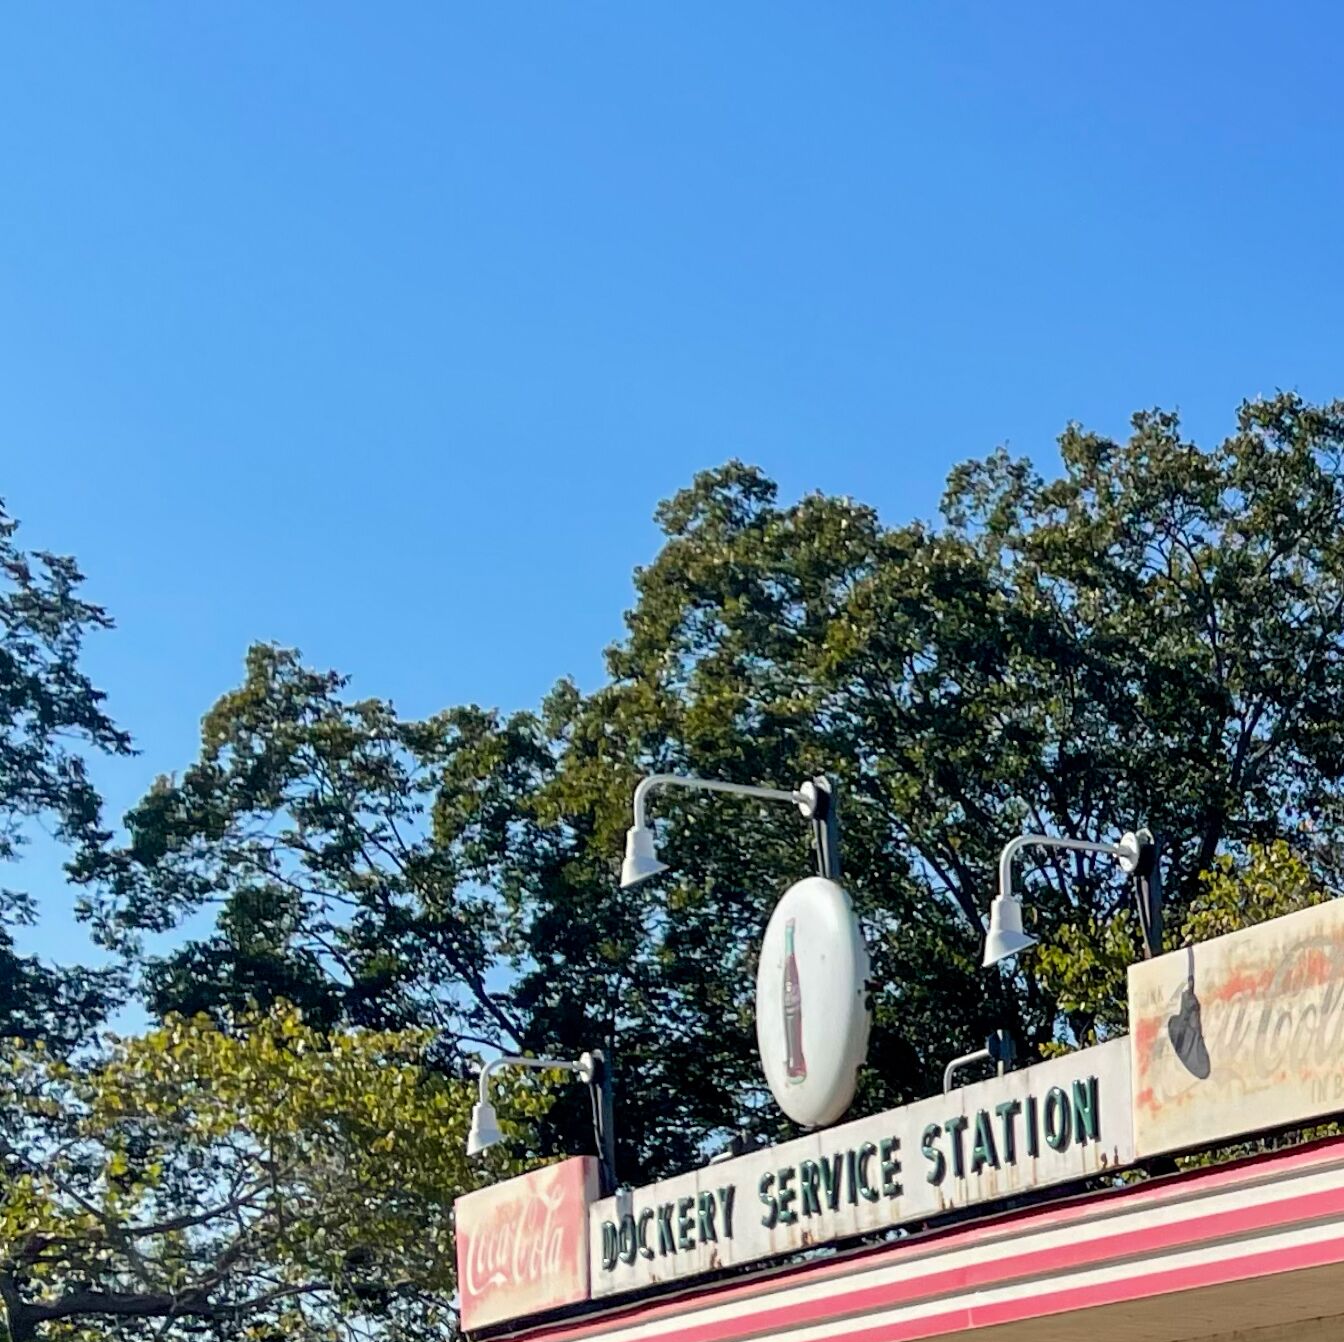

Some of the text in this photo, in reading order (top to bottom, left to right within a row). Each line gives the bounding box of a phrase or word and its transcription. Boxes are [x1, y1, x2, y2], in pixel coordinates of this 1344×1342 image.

[601, 1075, 1102, 1272] DOCKERY SERVICE STATION
